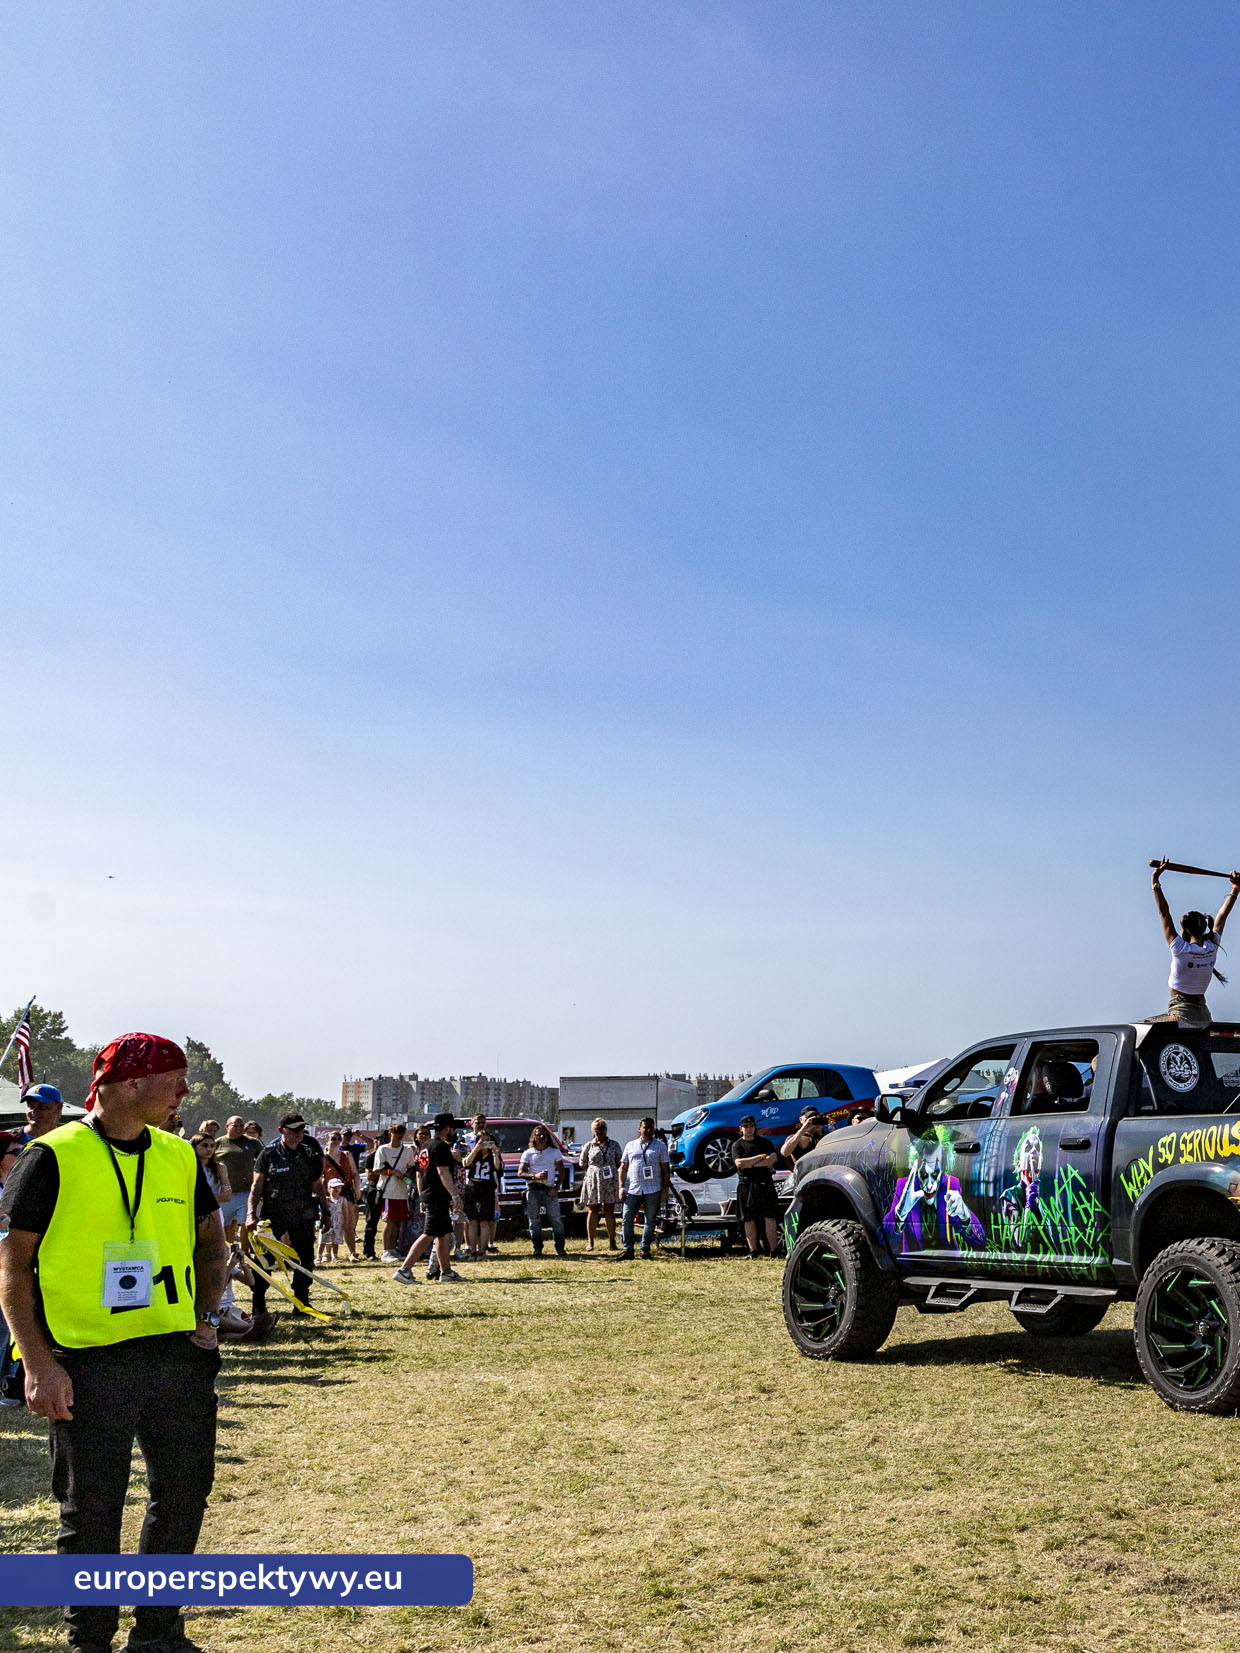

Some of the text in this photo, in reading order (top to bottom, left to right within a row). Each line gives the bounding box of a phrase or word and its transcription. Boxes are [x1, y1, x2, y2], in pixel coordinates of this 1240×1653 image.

[474, 1161, 491, 1180] 12
[1120, 1146, 1154, 1203] WHY
[1158, 1132, 1177, 1164] SO
